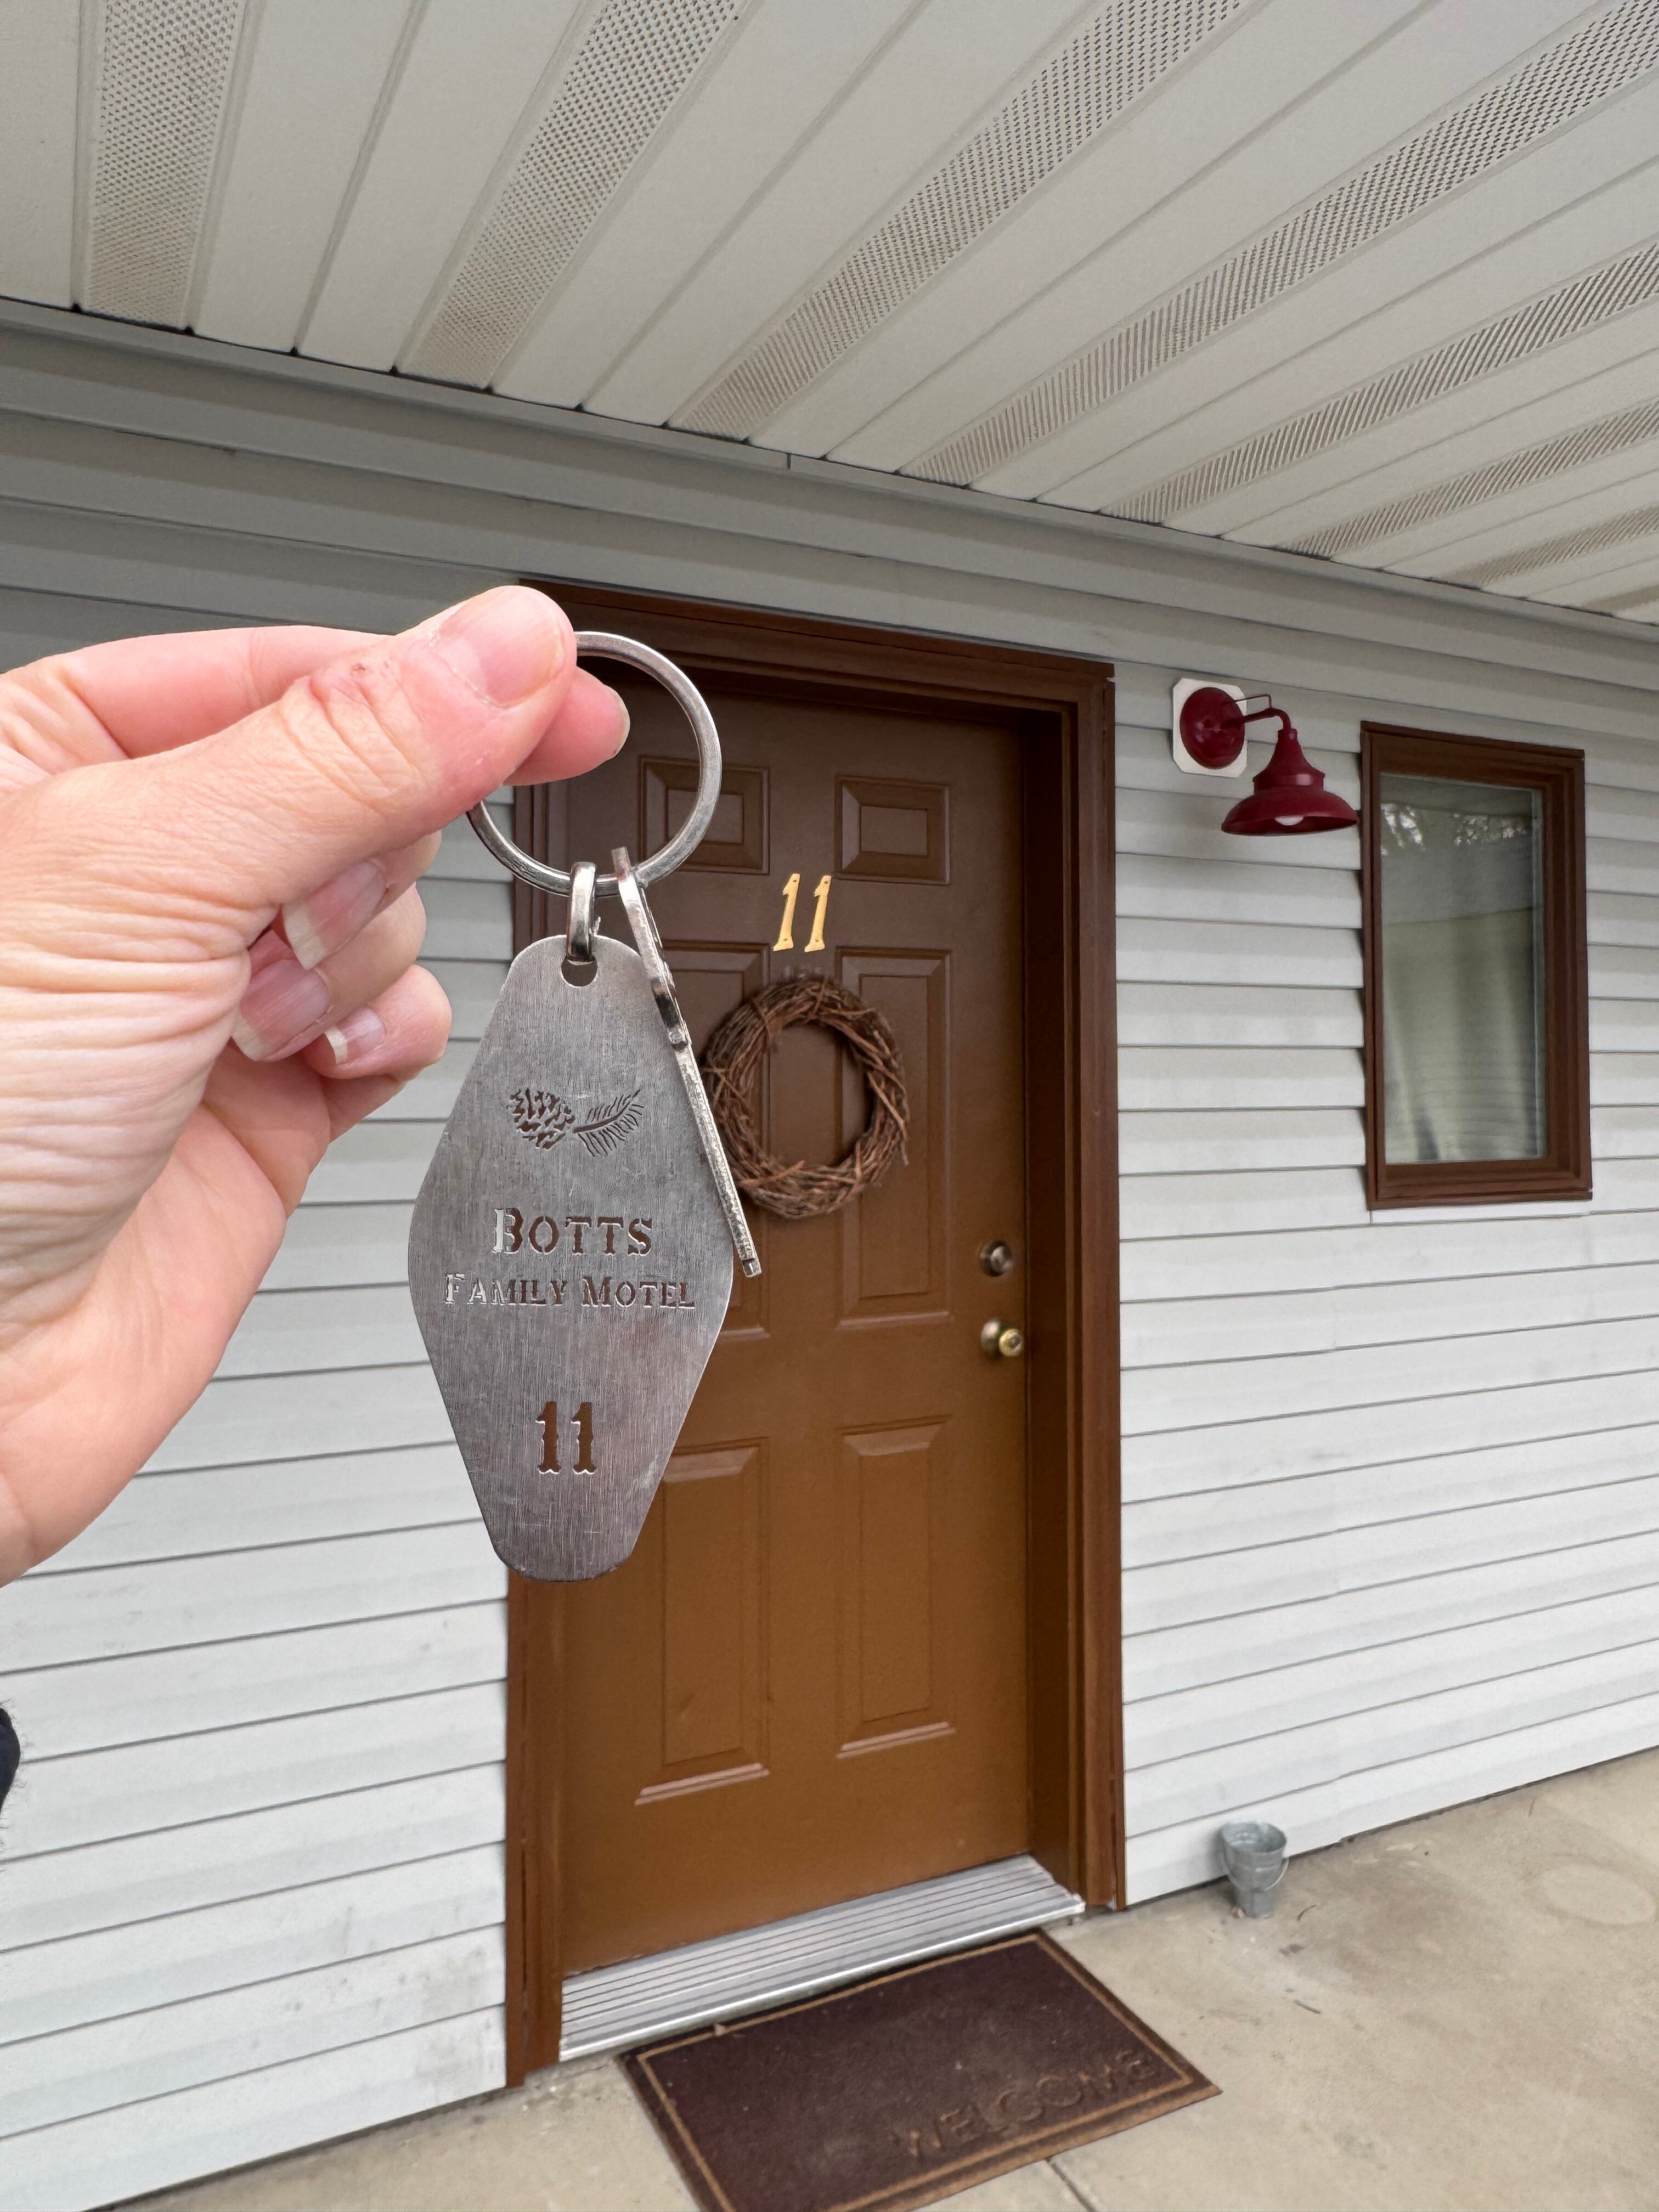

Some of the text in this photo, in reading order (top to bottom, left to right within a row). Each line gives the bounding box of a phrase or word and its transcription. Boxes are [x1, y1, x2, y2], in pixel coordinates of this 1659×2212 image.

[772, 873, 832, 952] 11
[492, 1207, 652, 1255] BOTTS
[443, 1273, 695, 1309] FAMILY MOTEL
[535, 1401, 596, 1475] 11
[892, 2048, 1156, 2158] WELCOME
